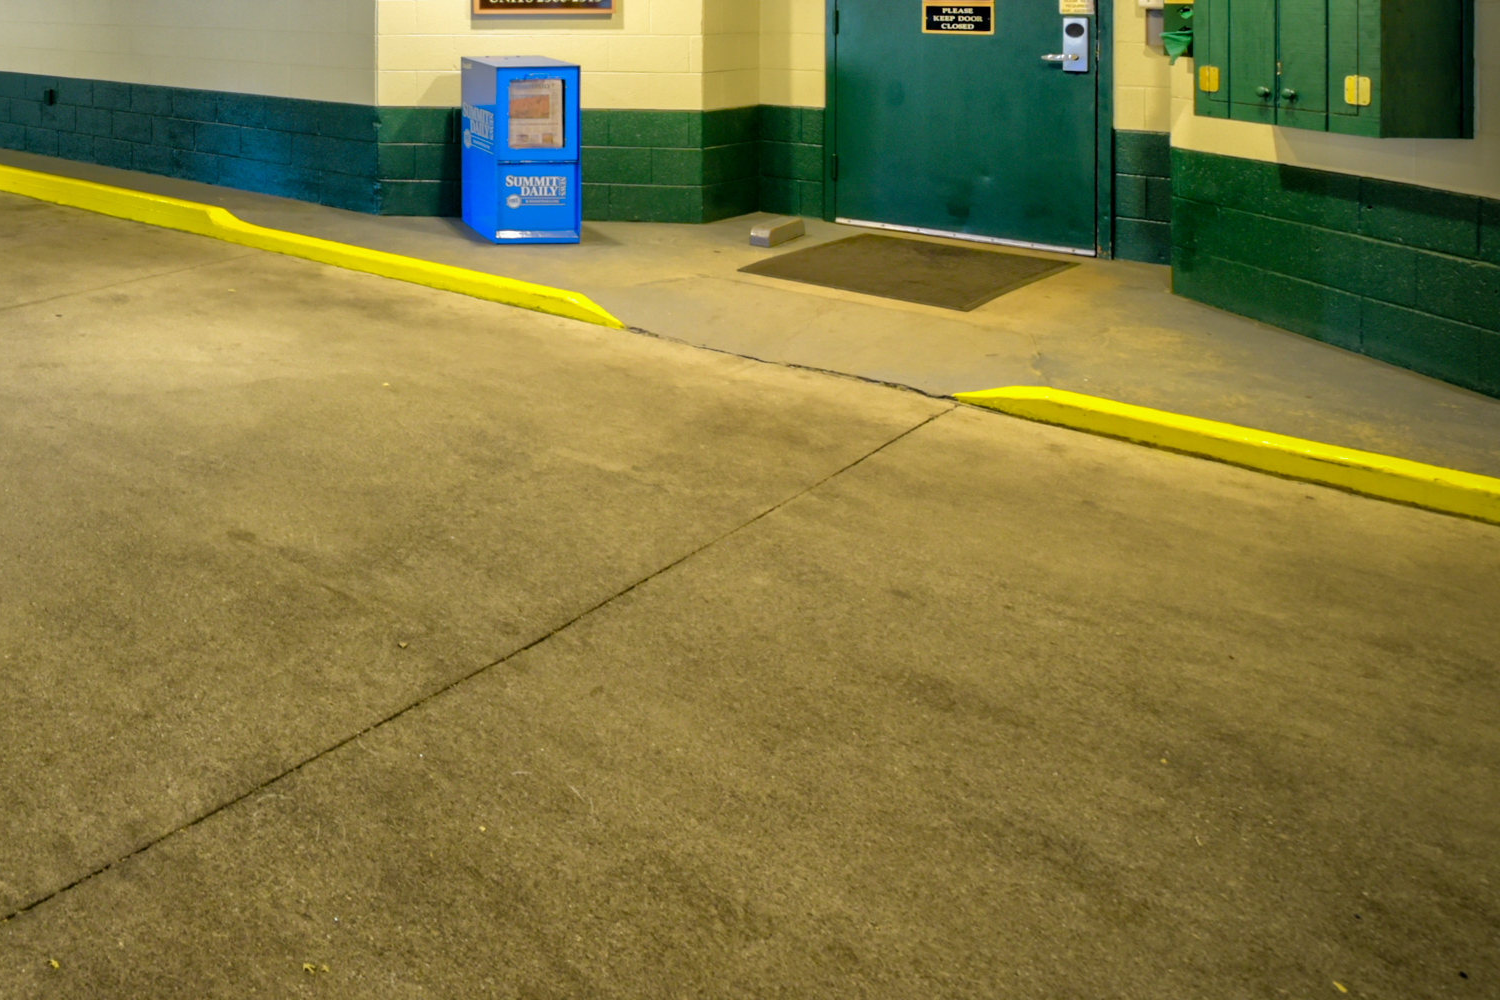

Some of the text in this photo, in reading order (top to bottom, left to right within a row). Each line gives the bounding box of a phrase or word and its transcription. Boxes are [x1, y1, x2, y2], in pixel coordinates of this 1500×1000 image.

[462, 101, 489, 124] SUMMIT
[470, 119, 490, 139] DAILY
[505, 175, 559, 187] SUMMIT
[520, 186, 558, 196] DAILY
